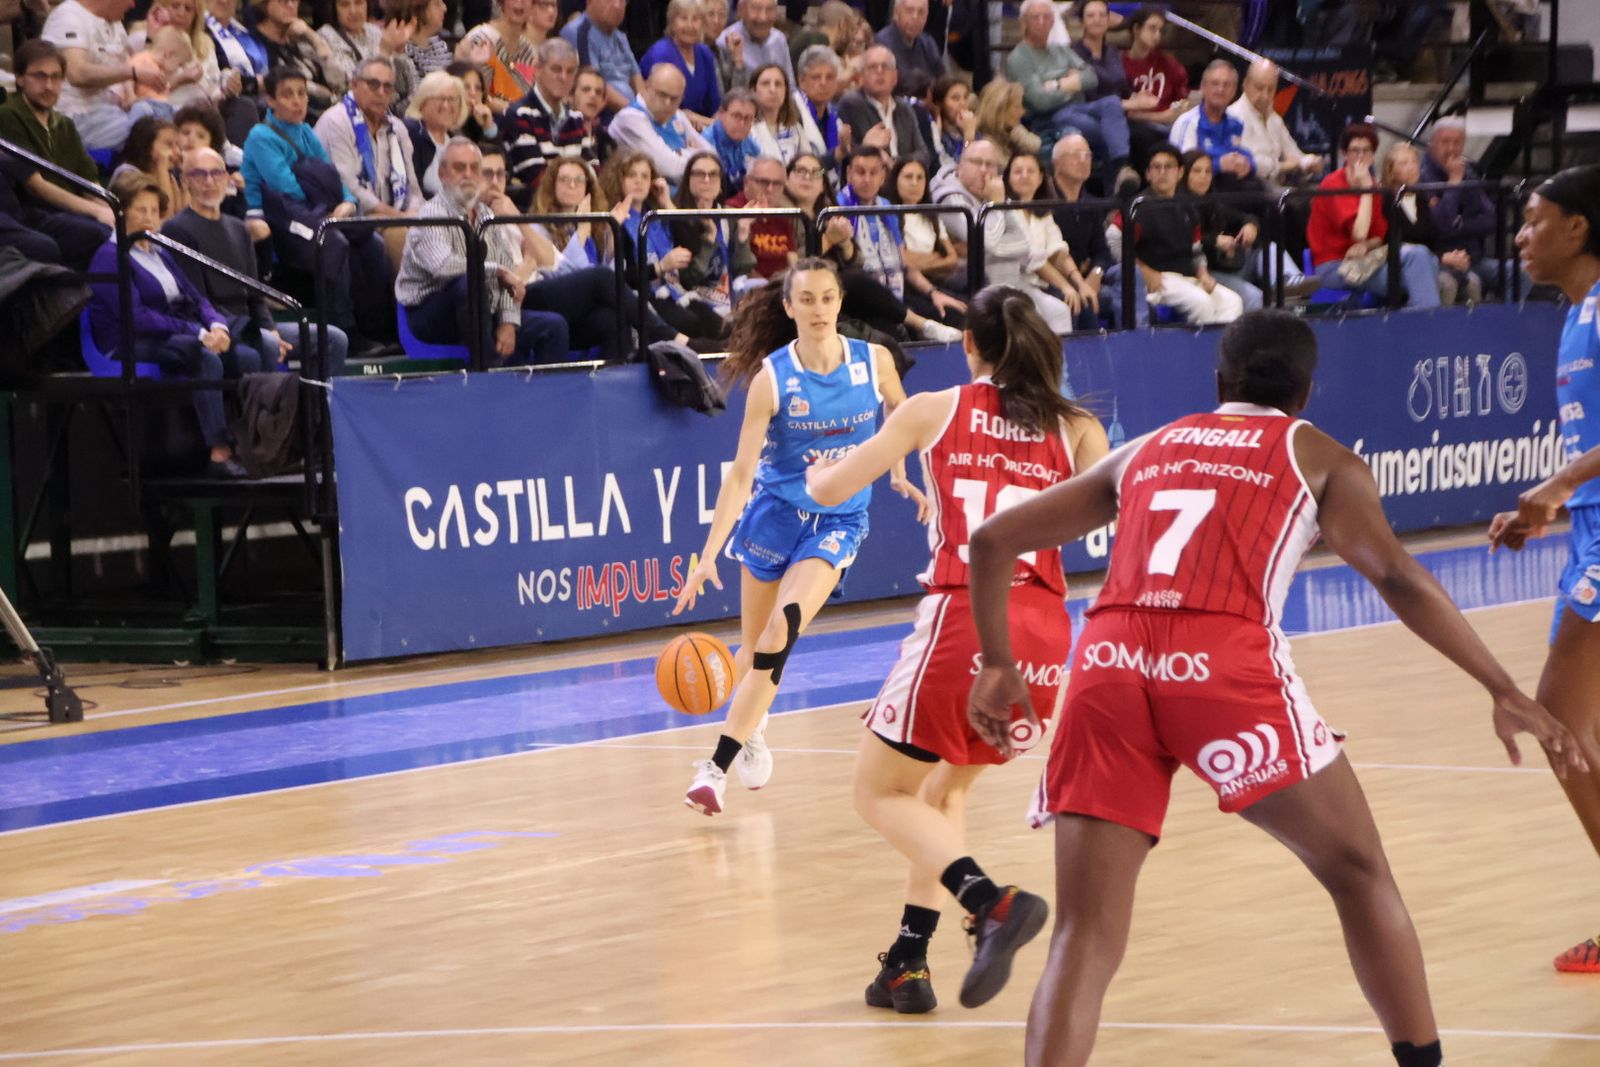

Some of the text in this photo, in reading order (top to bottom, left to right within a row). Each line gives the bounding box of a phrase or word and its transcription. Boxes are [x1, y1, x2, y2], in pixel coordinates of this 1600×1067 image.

[788, 418, 838, 431] CASTILLA
[842, 416, 849, 426] Y
[1159, 427, 1264, 448] FINGALL
[948, 452, 973, 467] AIR
[1132, 459, 1274, 488] AIR HORIZONT
[403, 460, 735, 551] CASTILLA Y L
[1148, 488, 1217, 577] 7
[517, 567, 571, 605] NOS
[1081, 640, 1211, 682] SOMMOS
[1219, 758, 1289, 797] ANGUAS
